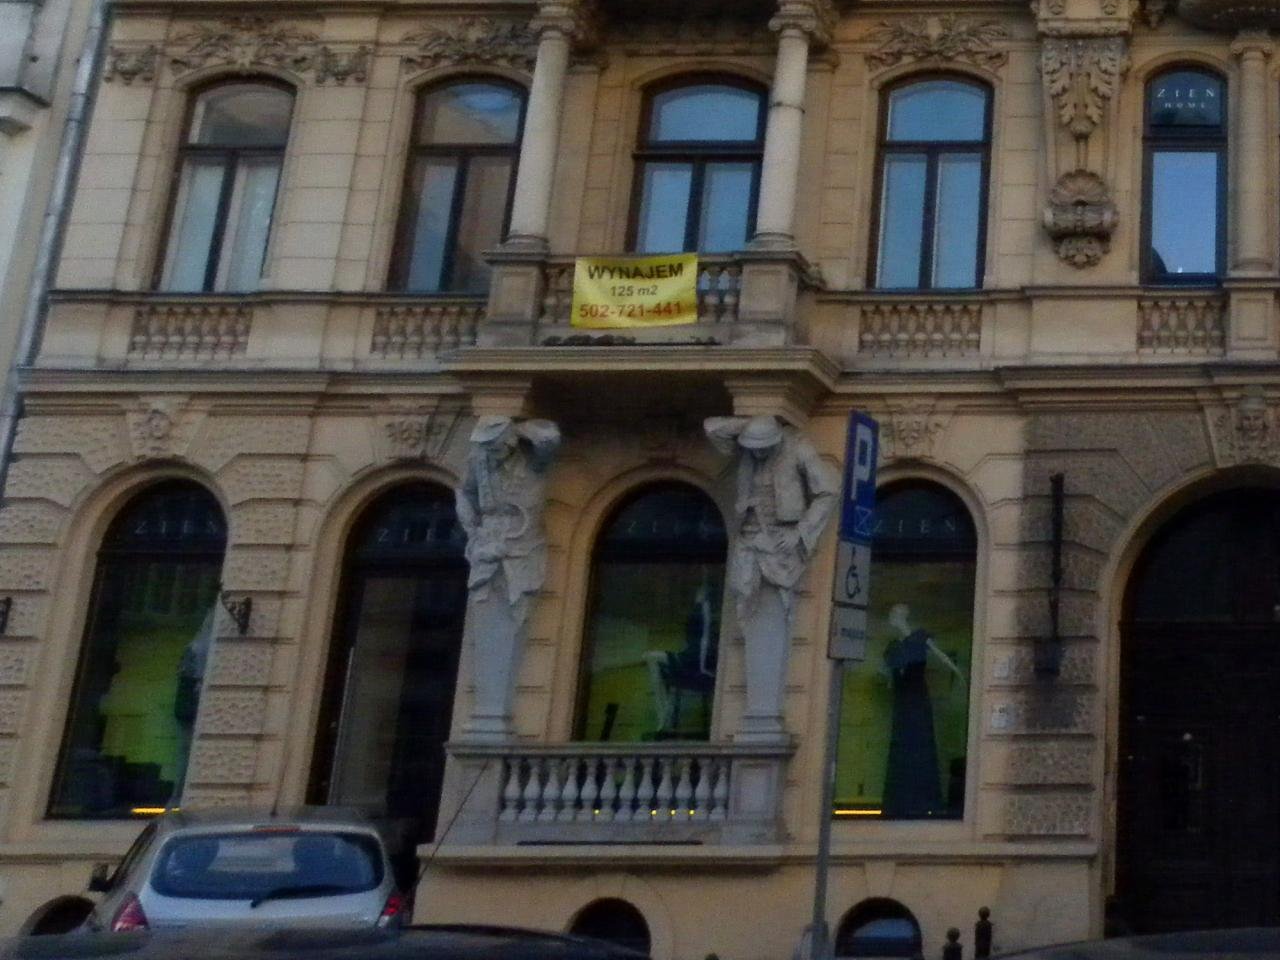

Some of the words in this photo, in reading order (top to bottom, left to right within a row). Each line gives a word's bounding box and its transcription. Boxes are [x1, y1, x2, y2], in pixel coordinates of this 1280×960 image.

[588, 262, 683, 280] WYNAJEM
[610, 285, 633, 297] 125
[637, 284, 658, 296] m2
[579, 301, 682, 318] 502-721-441
[850, 422, 873, 501] P
